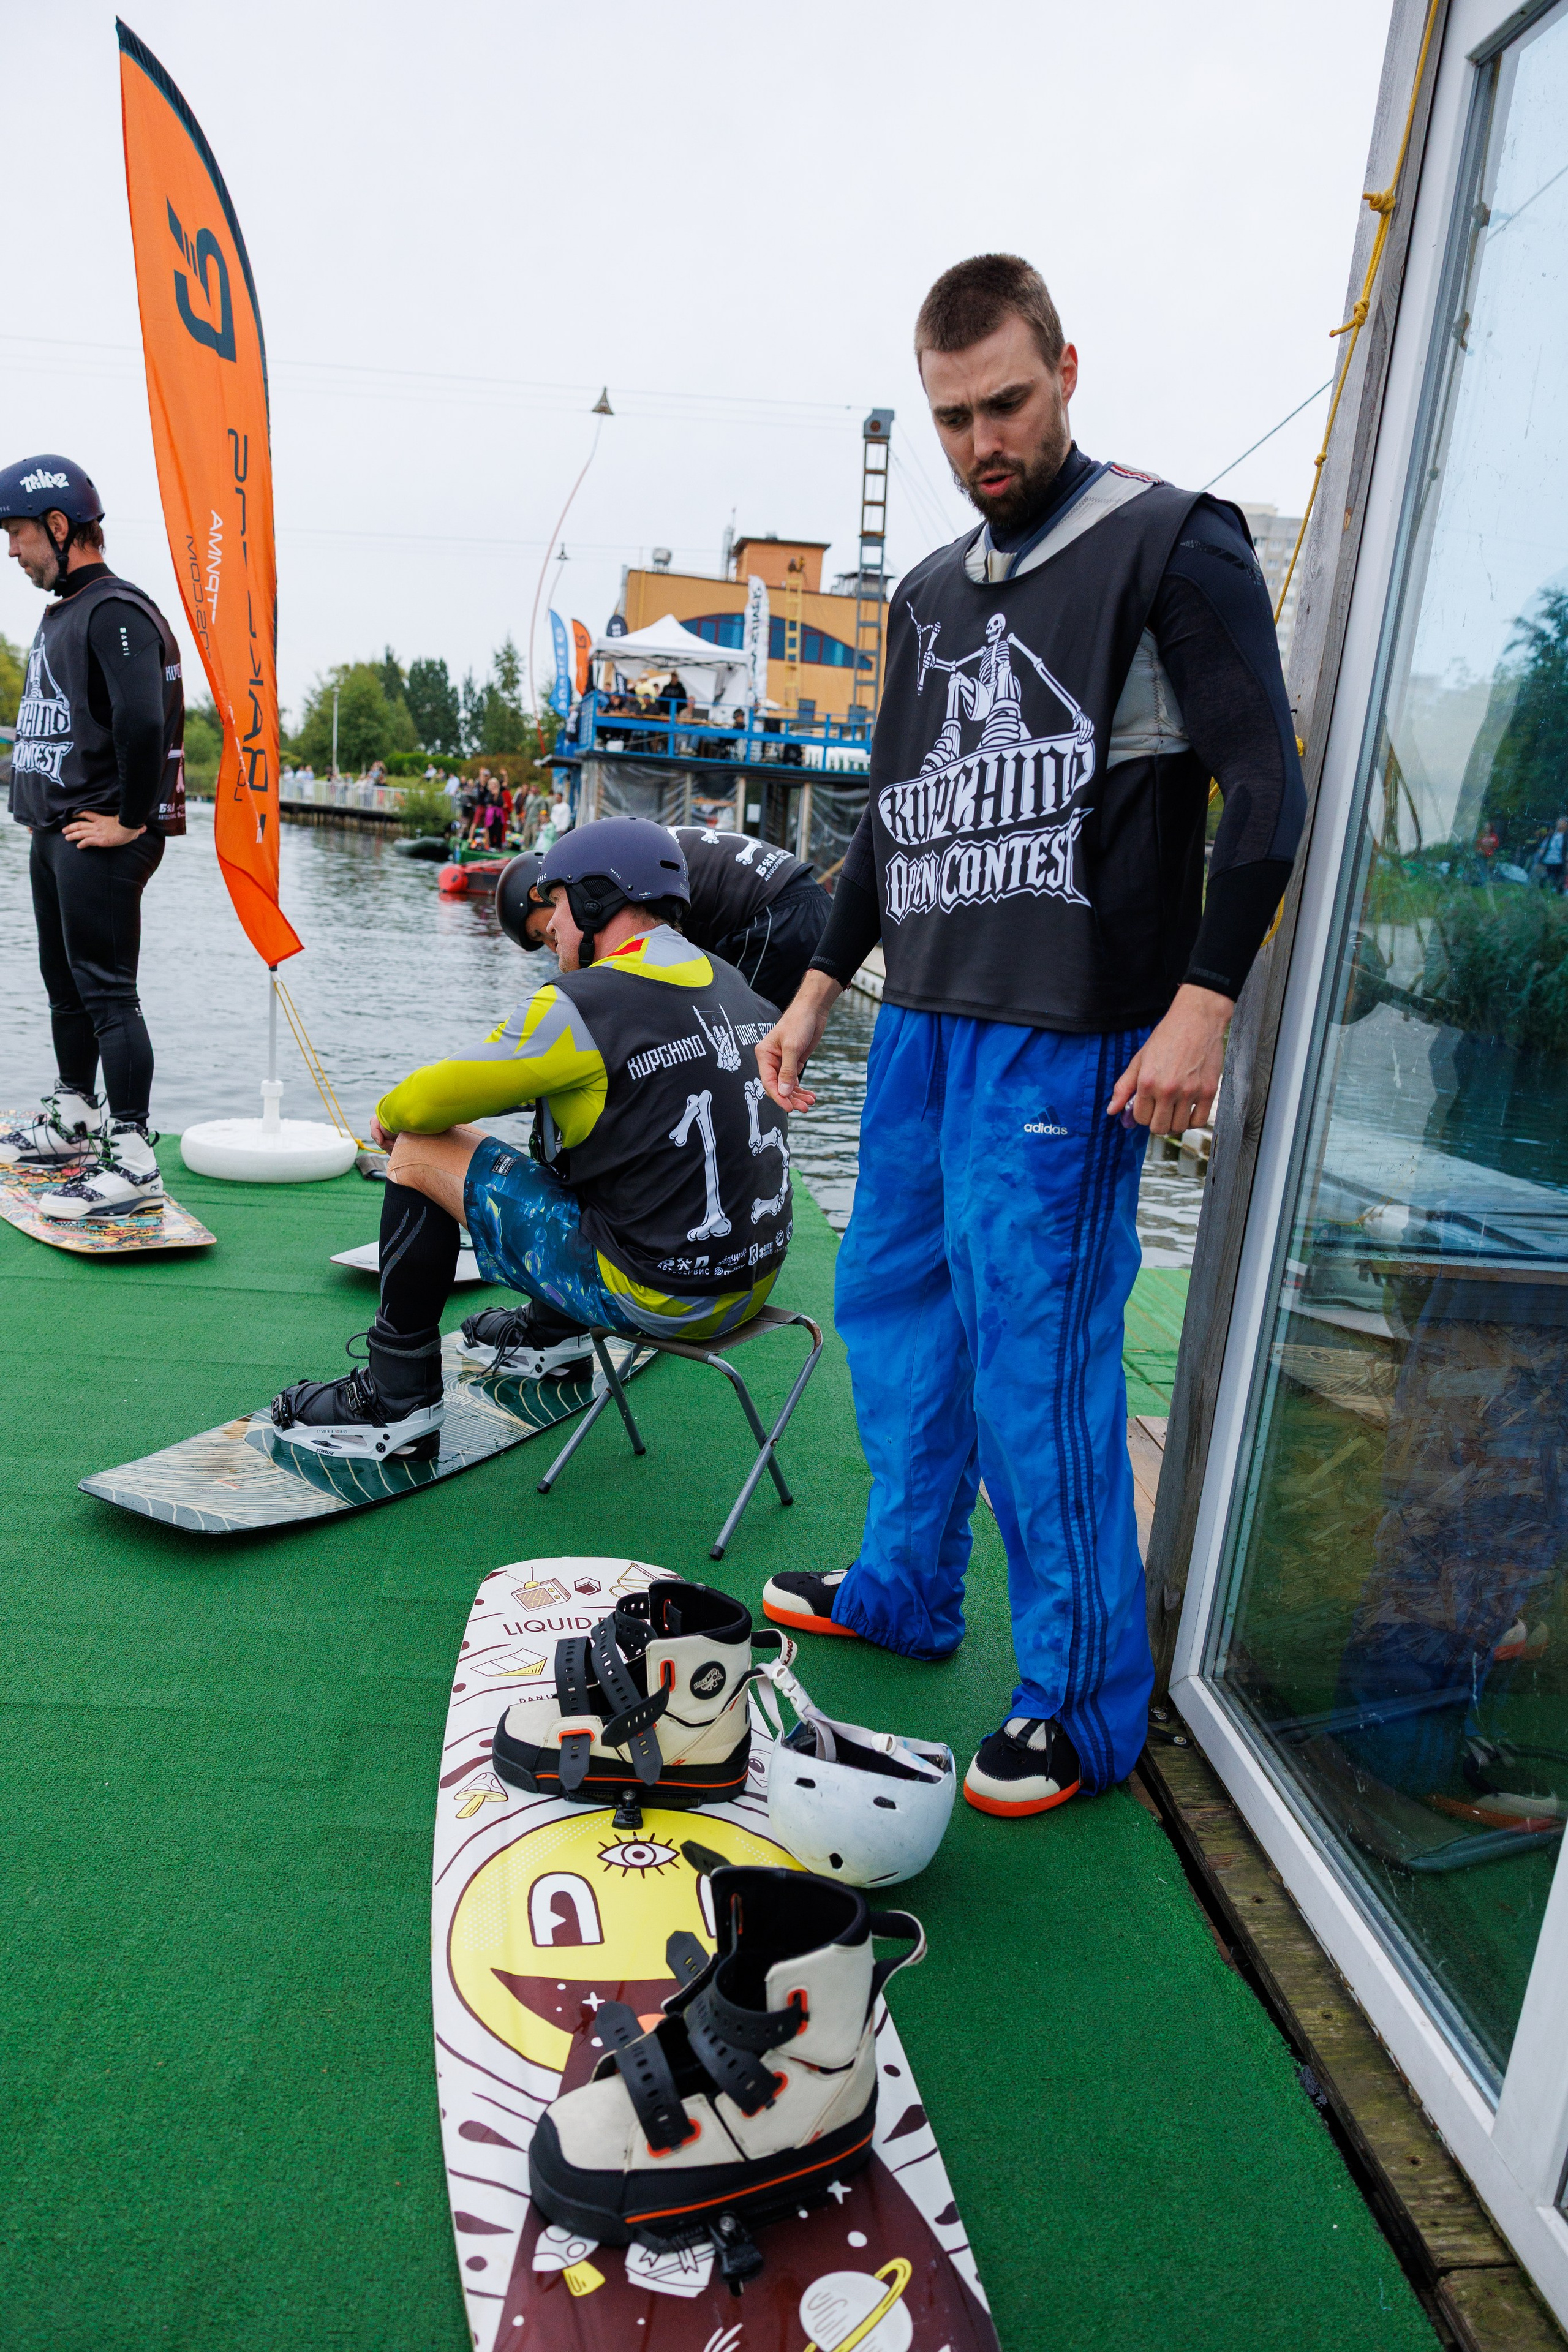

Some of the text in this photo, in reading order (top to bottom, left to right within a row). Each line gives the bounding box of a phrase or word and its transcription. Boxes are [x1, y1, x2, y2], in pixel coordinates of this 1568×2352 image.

[13, 742, 70, 779] ONTEST
[941, 816, 1085, 909] CONTEST
[734, 1023, 762, 1046] WAKE
[1023, 1123, 1068, 1135] adidas
[502, 1617, 592, 1636] LIQUID
